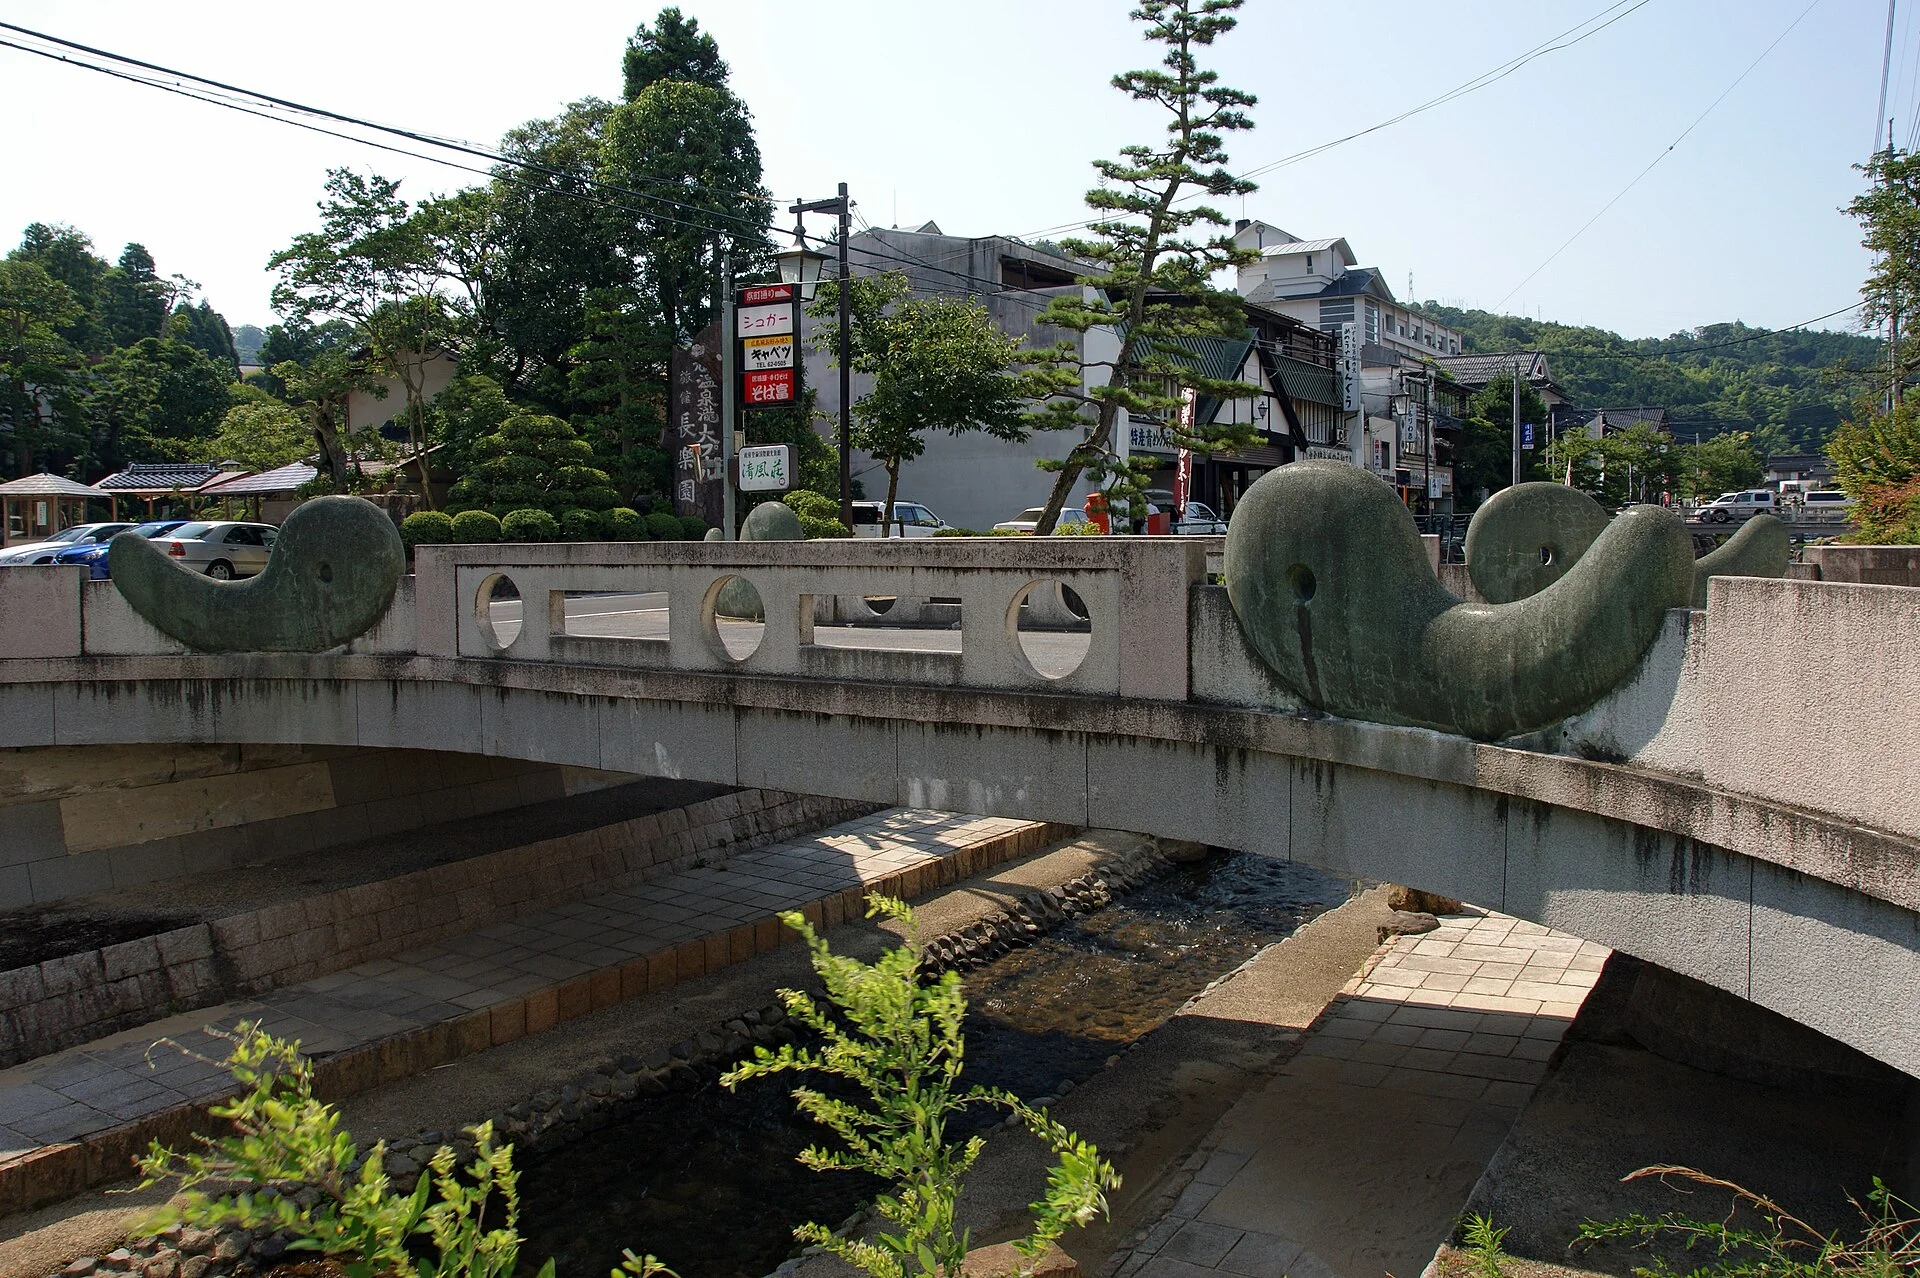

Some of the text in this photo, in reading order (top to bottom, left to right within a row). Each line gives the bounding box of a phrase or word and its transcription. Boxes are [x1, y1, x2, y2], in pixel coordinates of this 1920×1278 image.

[751, 345, 791, 360] キャベツ
[751, 383, 789, 401] そば富
[742, 459, 784, 480] 清風荘
